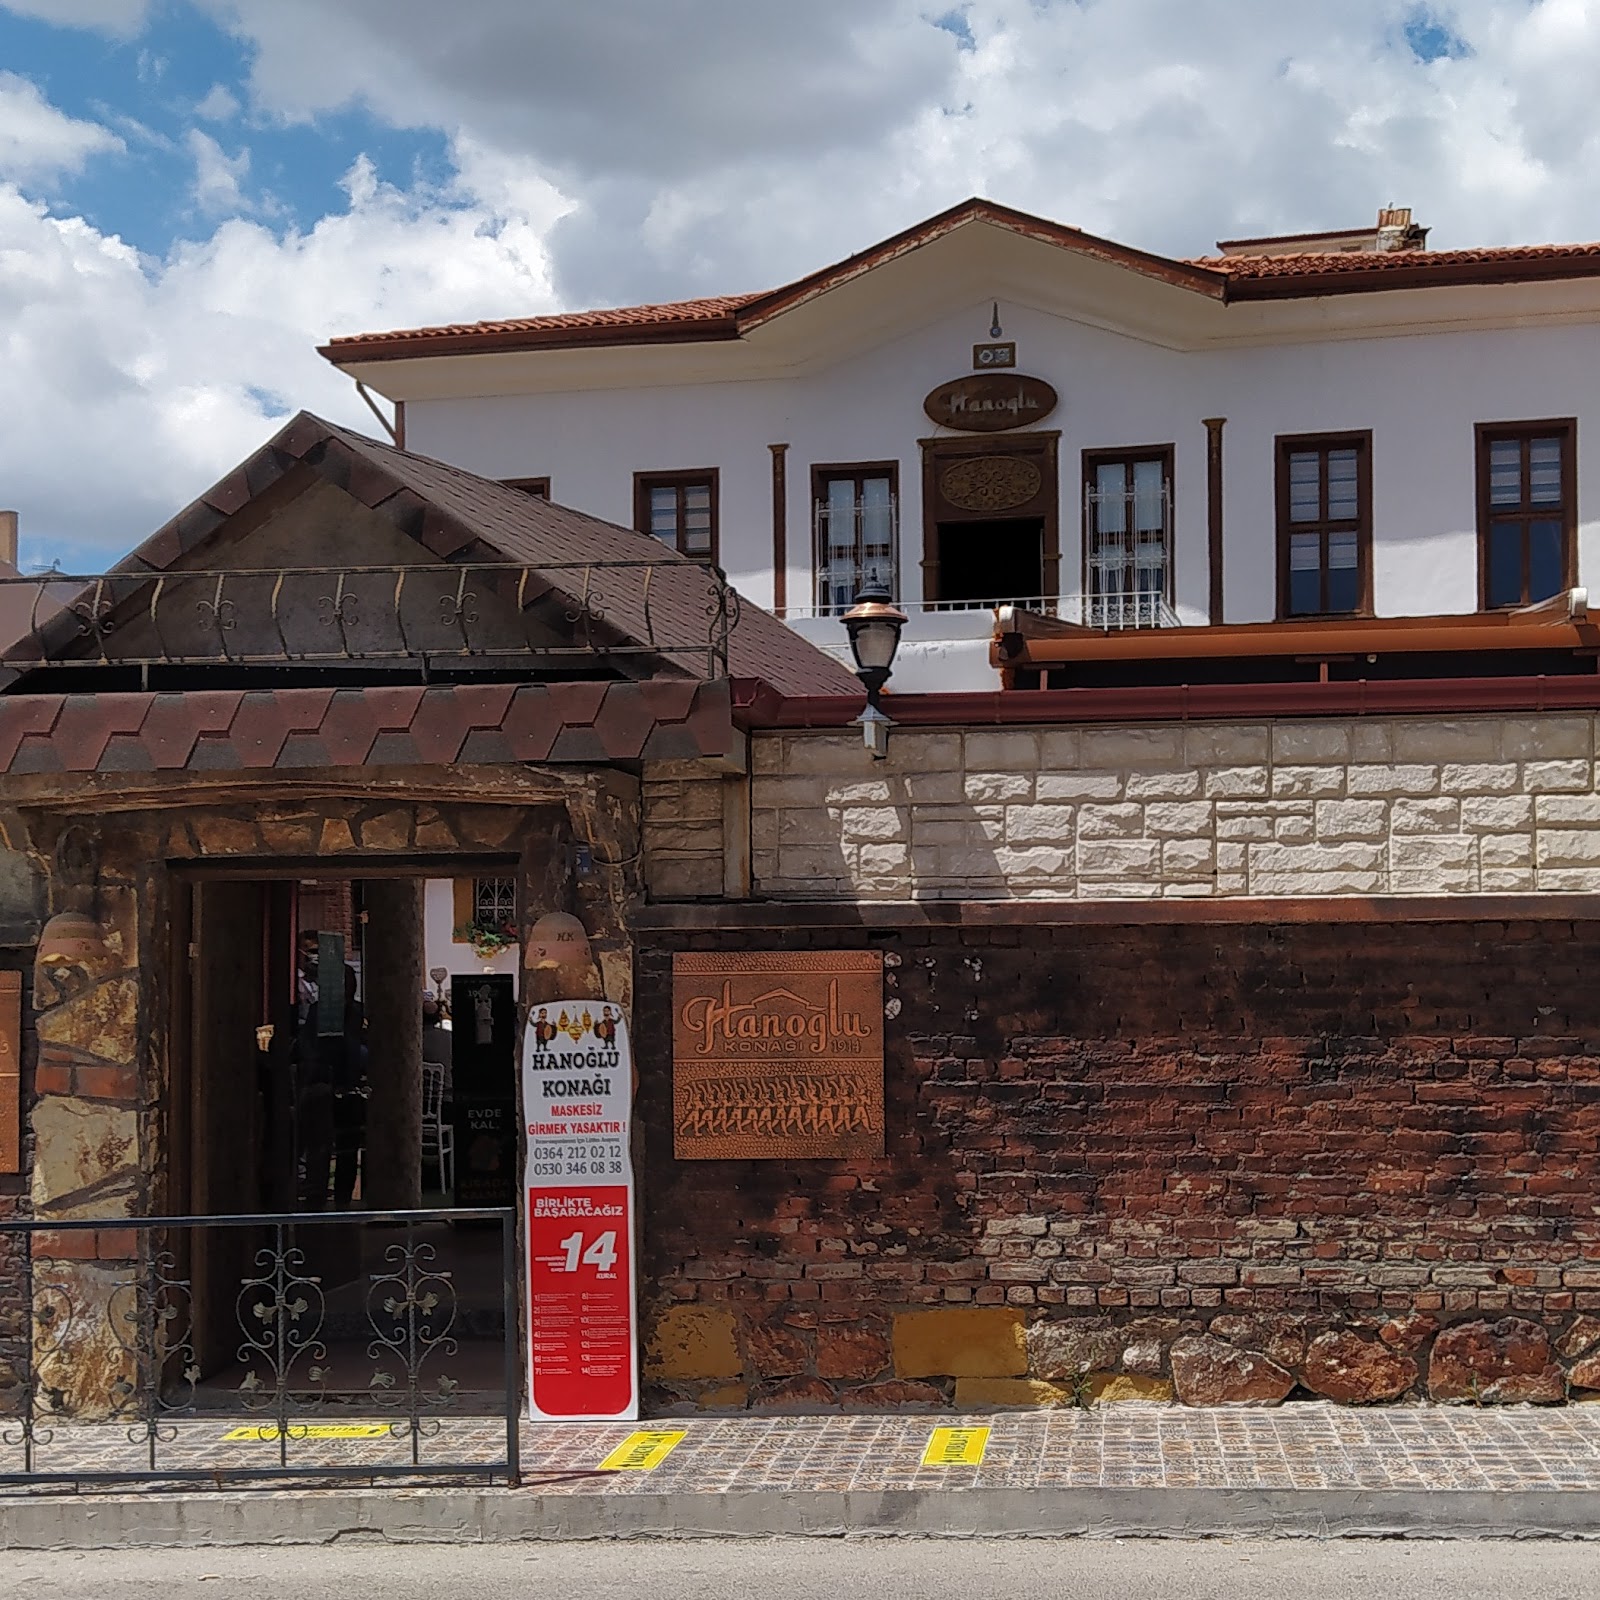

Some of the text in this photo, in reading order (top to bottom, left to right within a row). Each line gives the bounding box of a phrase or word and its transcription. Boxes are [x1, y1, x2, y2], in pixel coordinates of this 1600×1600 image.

[532, 1046, 620, 1071] HANOĞLU
[542, 1073, 612, 1098] KONAĞI
[467, 1108, 502, 1119] EVDE
[551, 1102, 603, 1117] MASKESİZ
[528, 1121, 568, 1136] GİRMEK
[571, 1121, 620, 1135] YASAKTIR
[533, 1145, 622, 1160] 0364 212 02 12
[533, 1160, 623, 1177] 0530 346 08 38
[536, 1196, 592, 1209] BİRLİKTE
[533, 1203, 624, 1219] BAŞARACAĞIZ
[560, 1230, 618, 1273] 14
